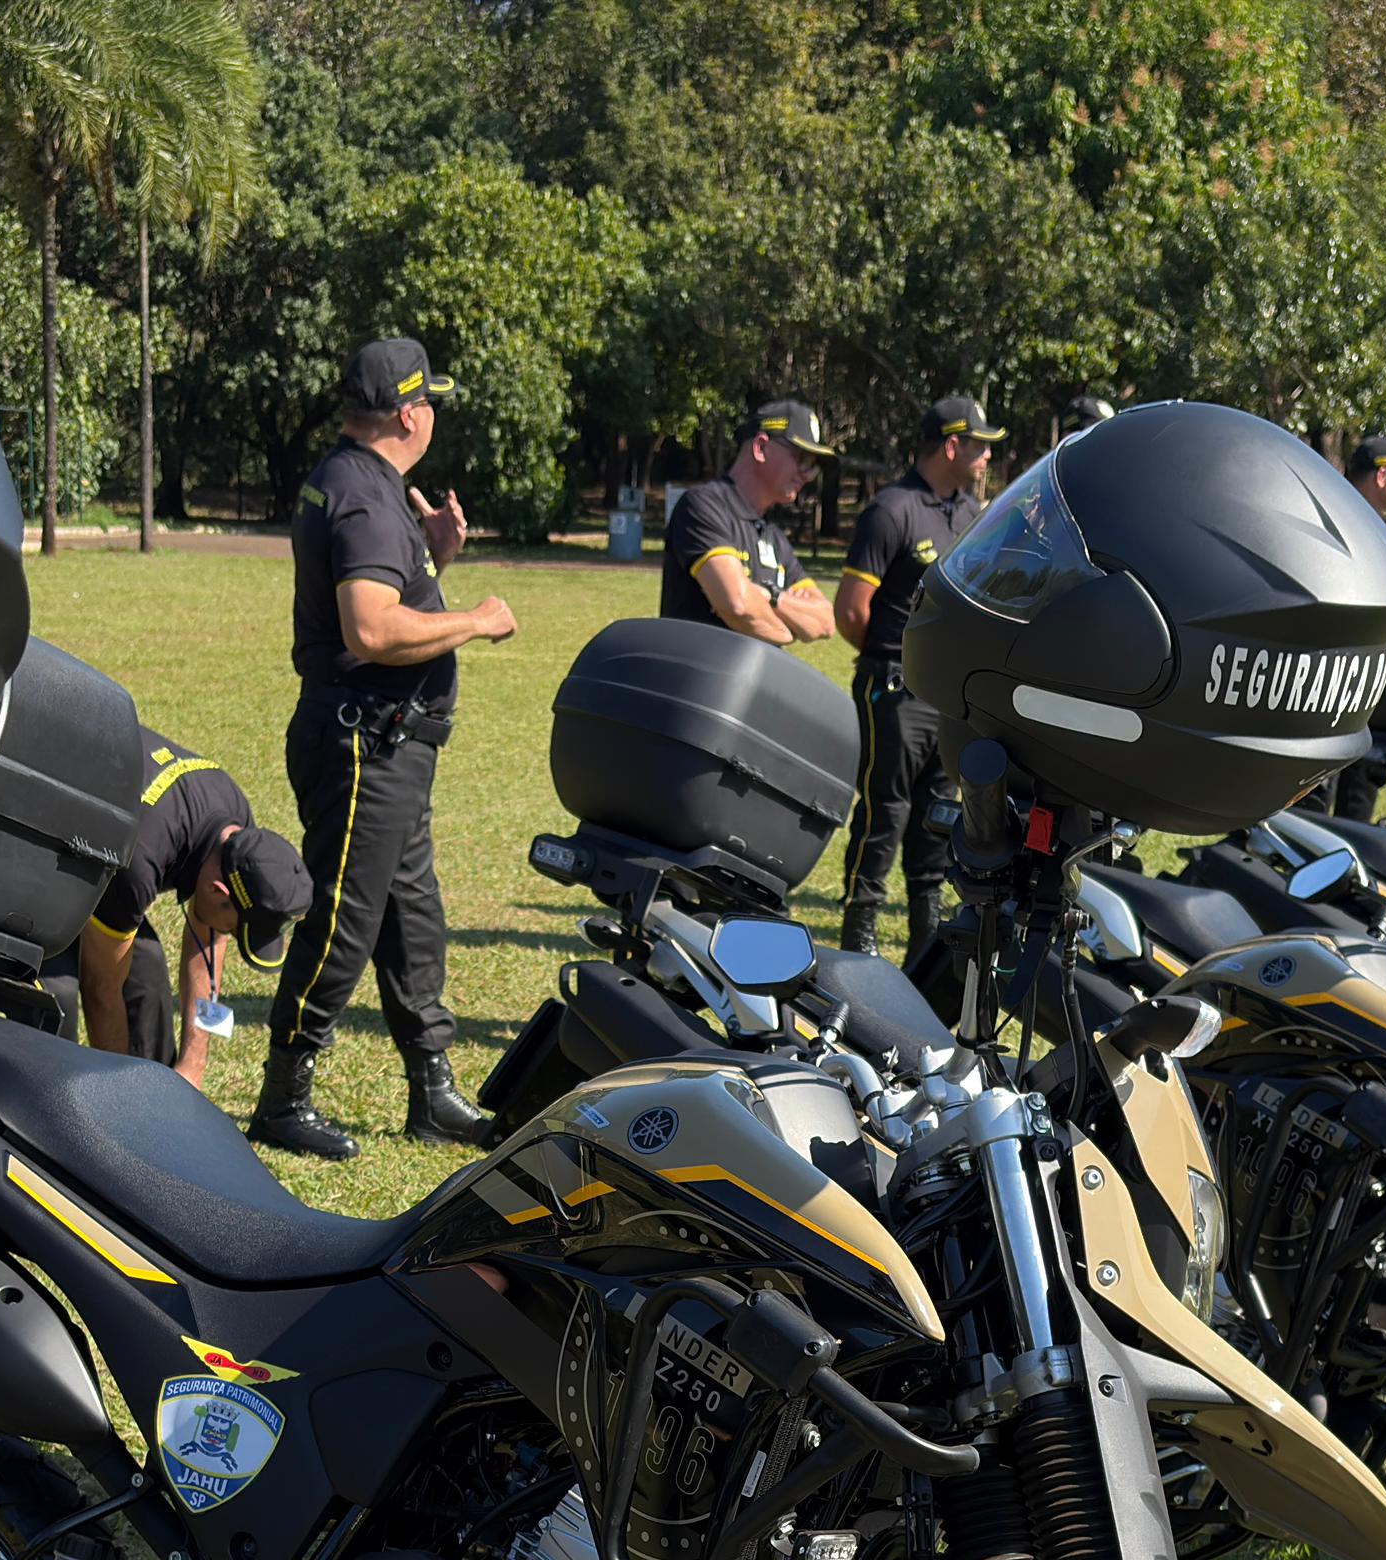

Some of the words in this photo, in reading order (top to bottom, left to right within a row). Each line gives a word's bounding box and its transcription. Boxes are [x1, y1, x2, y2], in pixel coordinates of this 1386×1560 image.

[1205, 644, 1370, 727] SEGURANÇA
[1252, 1111, 1323, 1160] XT250
[1260, 1088, 1337, 1142] LADER
[666, 1324, 740, 1388] NDER
[166, 1380, 226, 1396] SEGURANÇA
[226, 1385, 280, 1432] PATRIMONIAL
[655, 1356, 721, 1412] Z250
[606, 1370, 715, 1496] 196
[177, 1463, 229, 1497] JAHU
[189, 1492, 207, 1508] SP
